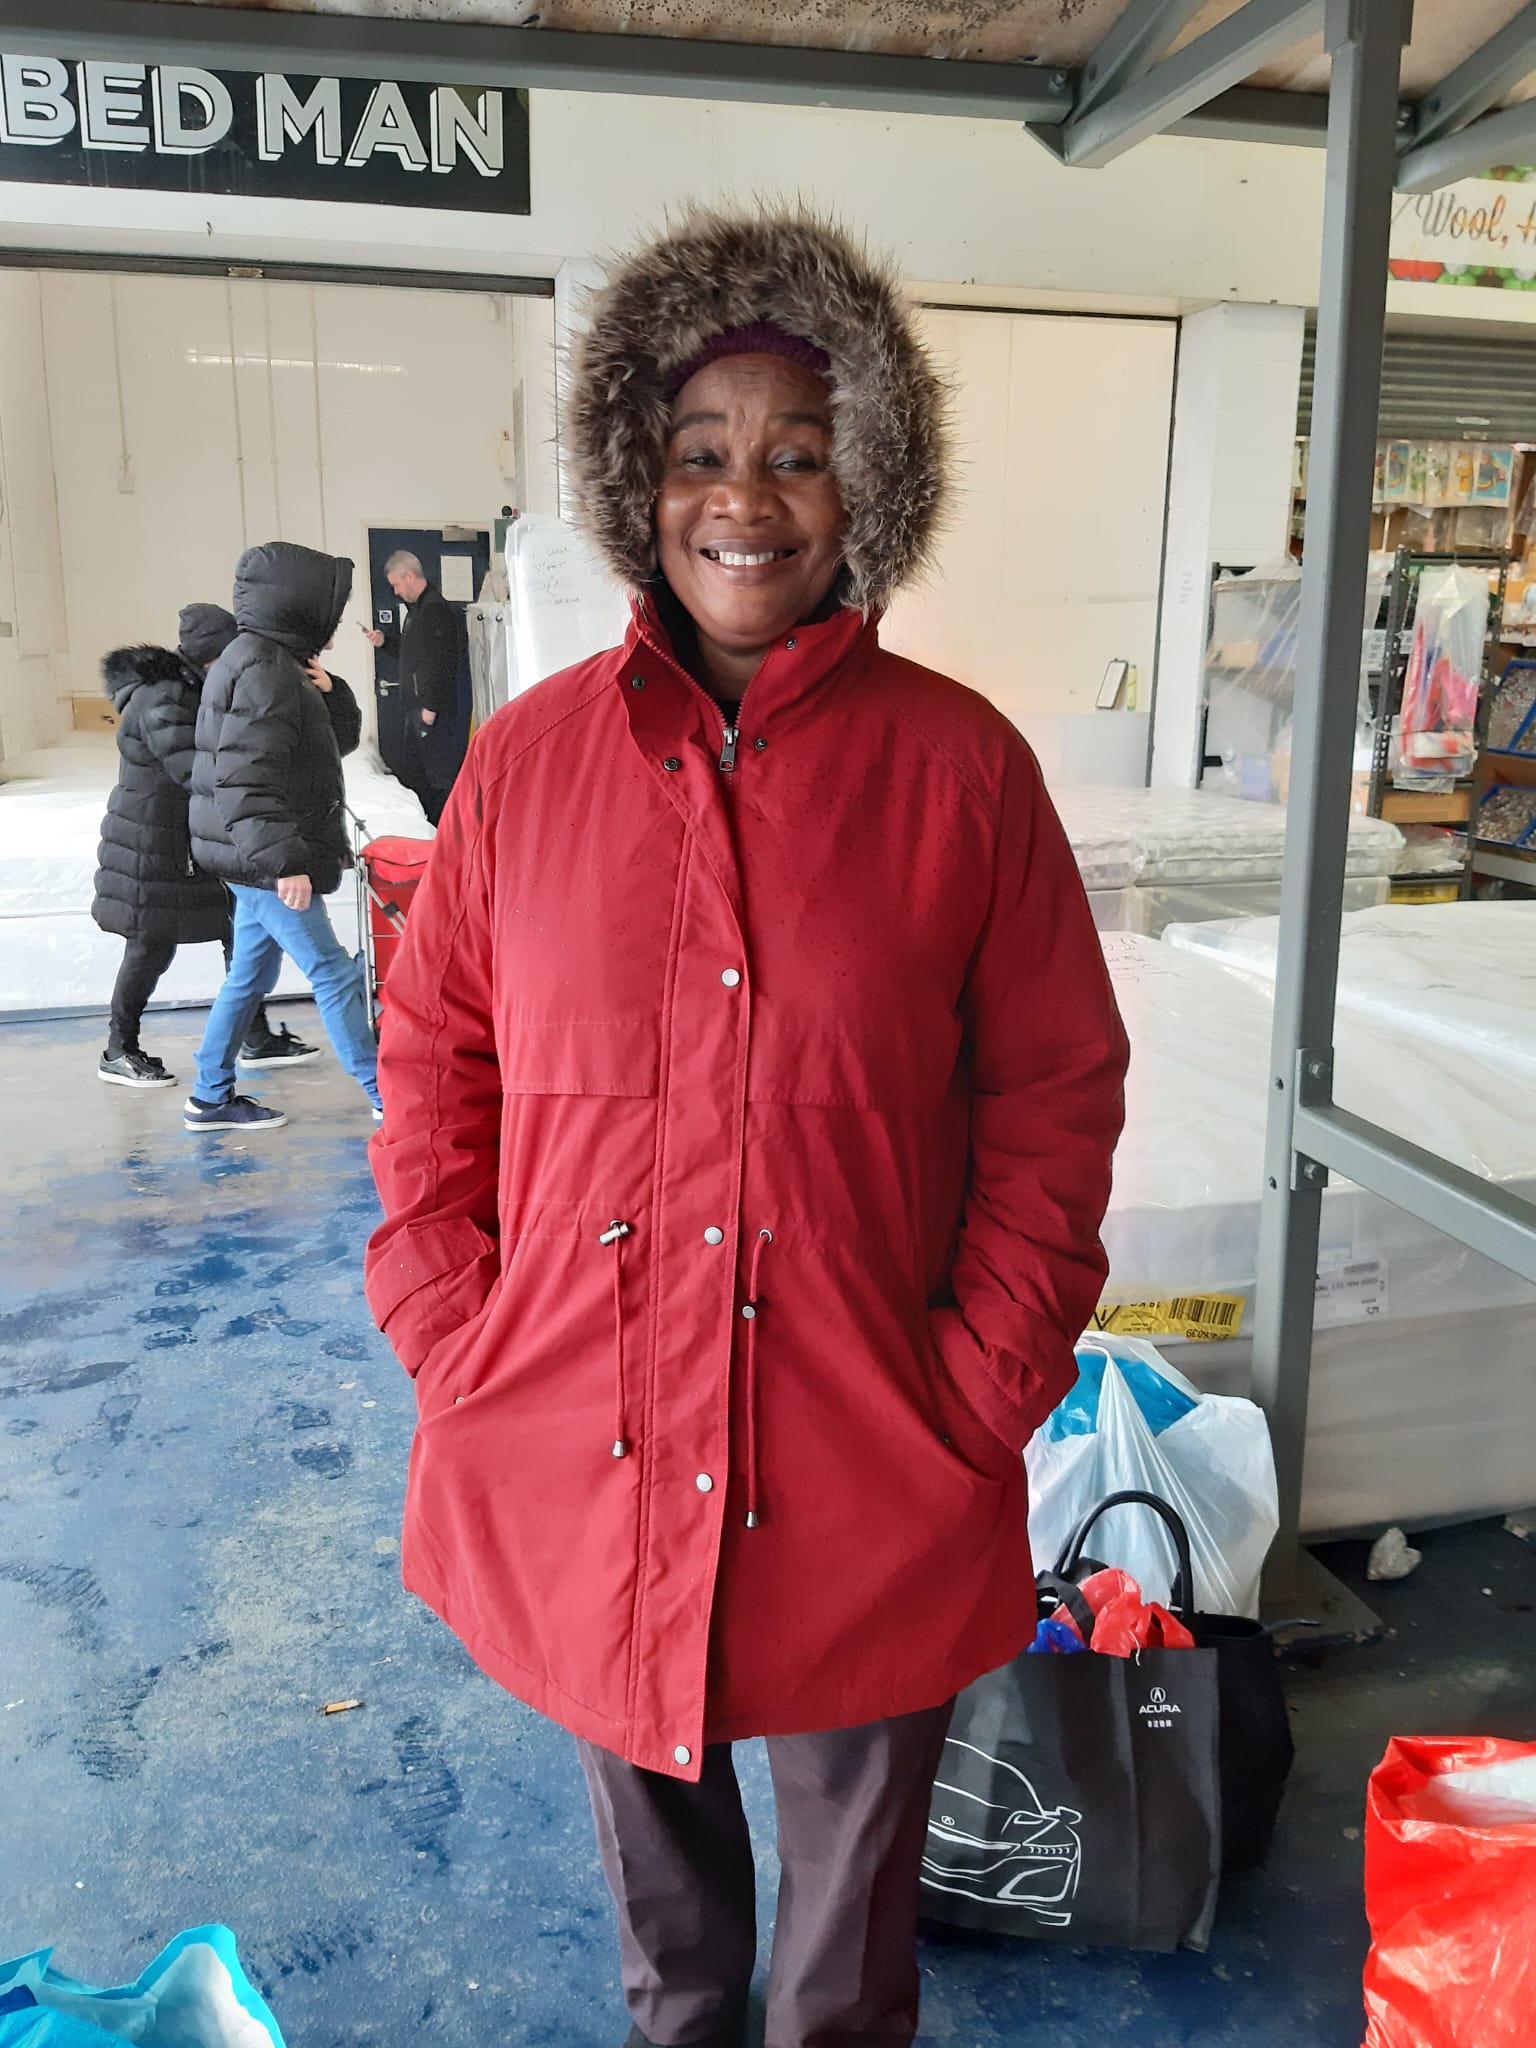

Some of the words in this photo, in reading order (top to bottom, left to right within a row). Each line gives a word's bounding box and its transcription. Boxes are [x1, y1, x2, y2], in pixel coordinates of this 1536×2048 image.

[0, 54, 233, 155] BED
[256, 73, 504, 178] MAN
[1139, 1704, 1182, 1714] ACURA
